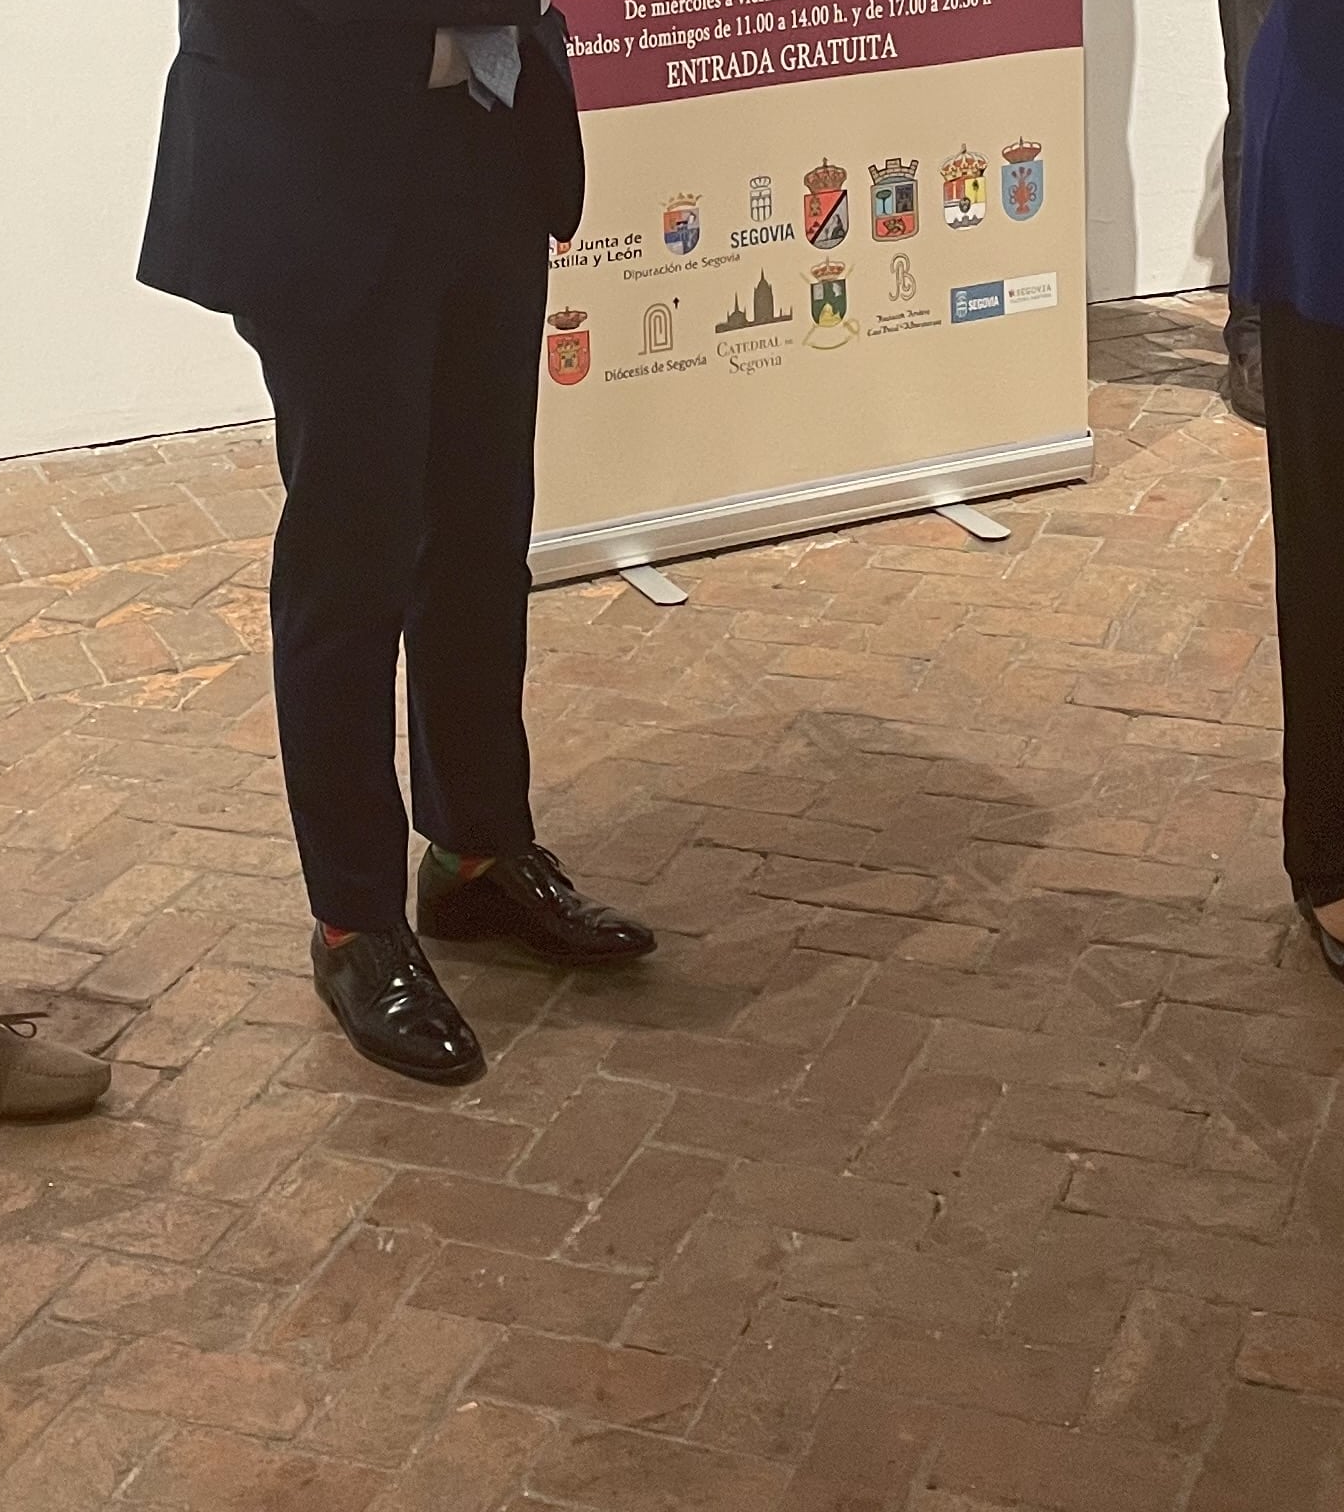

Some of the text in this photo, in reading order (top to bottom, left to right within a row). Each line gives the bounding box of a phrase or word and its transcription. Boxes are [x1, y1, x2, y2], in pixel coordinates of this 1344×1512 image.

[564, 32, 621, 58] ábados
[624, 36, 635, 58] y
[639, 24, 710, 50] domingos
[714, 17, 732, 39] de
[736, 12, 774, 36] 11.00
[777, 15, 786, 30] a
[791, 5, 829, 29] 14.00
[833, 3, 848, 24] h.
[852, 5, 862, 26] y
[865, 0, 884, 20] de
[666, 32, 898, 88] ENTRADA GRATUITA
[576, 232, 643, 252] Junta de
[730, 222, 795, 249] SEGOVIA
[549, 247, 643, 269] stilla y León
[623, 252, 741, 282] Diputación de Segovia
[604, 354, 707, 383] Diócesis de Segovia
[728, 355, 783, 376] Segovia
